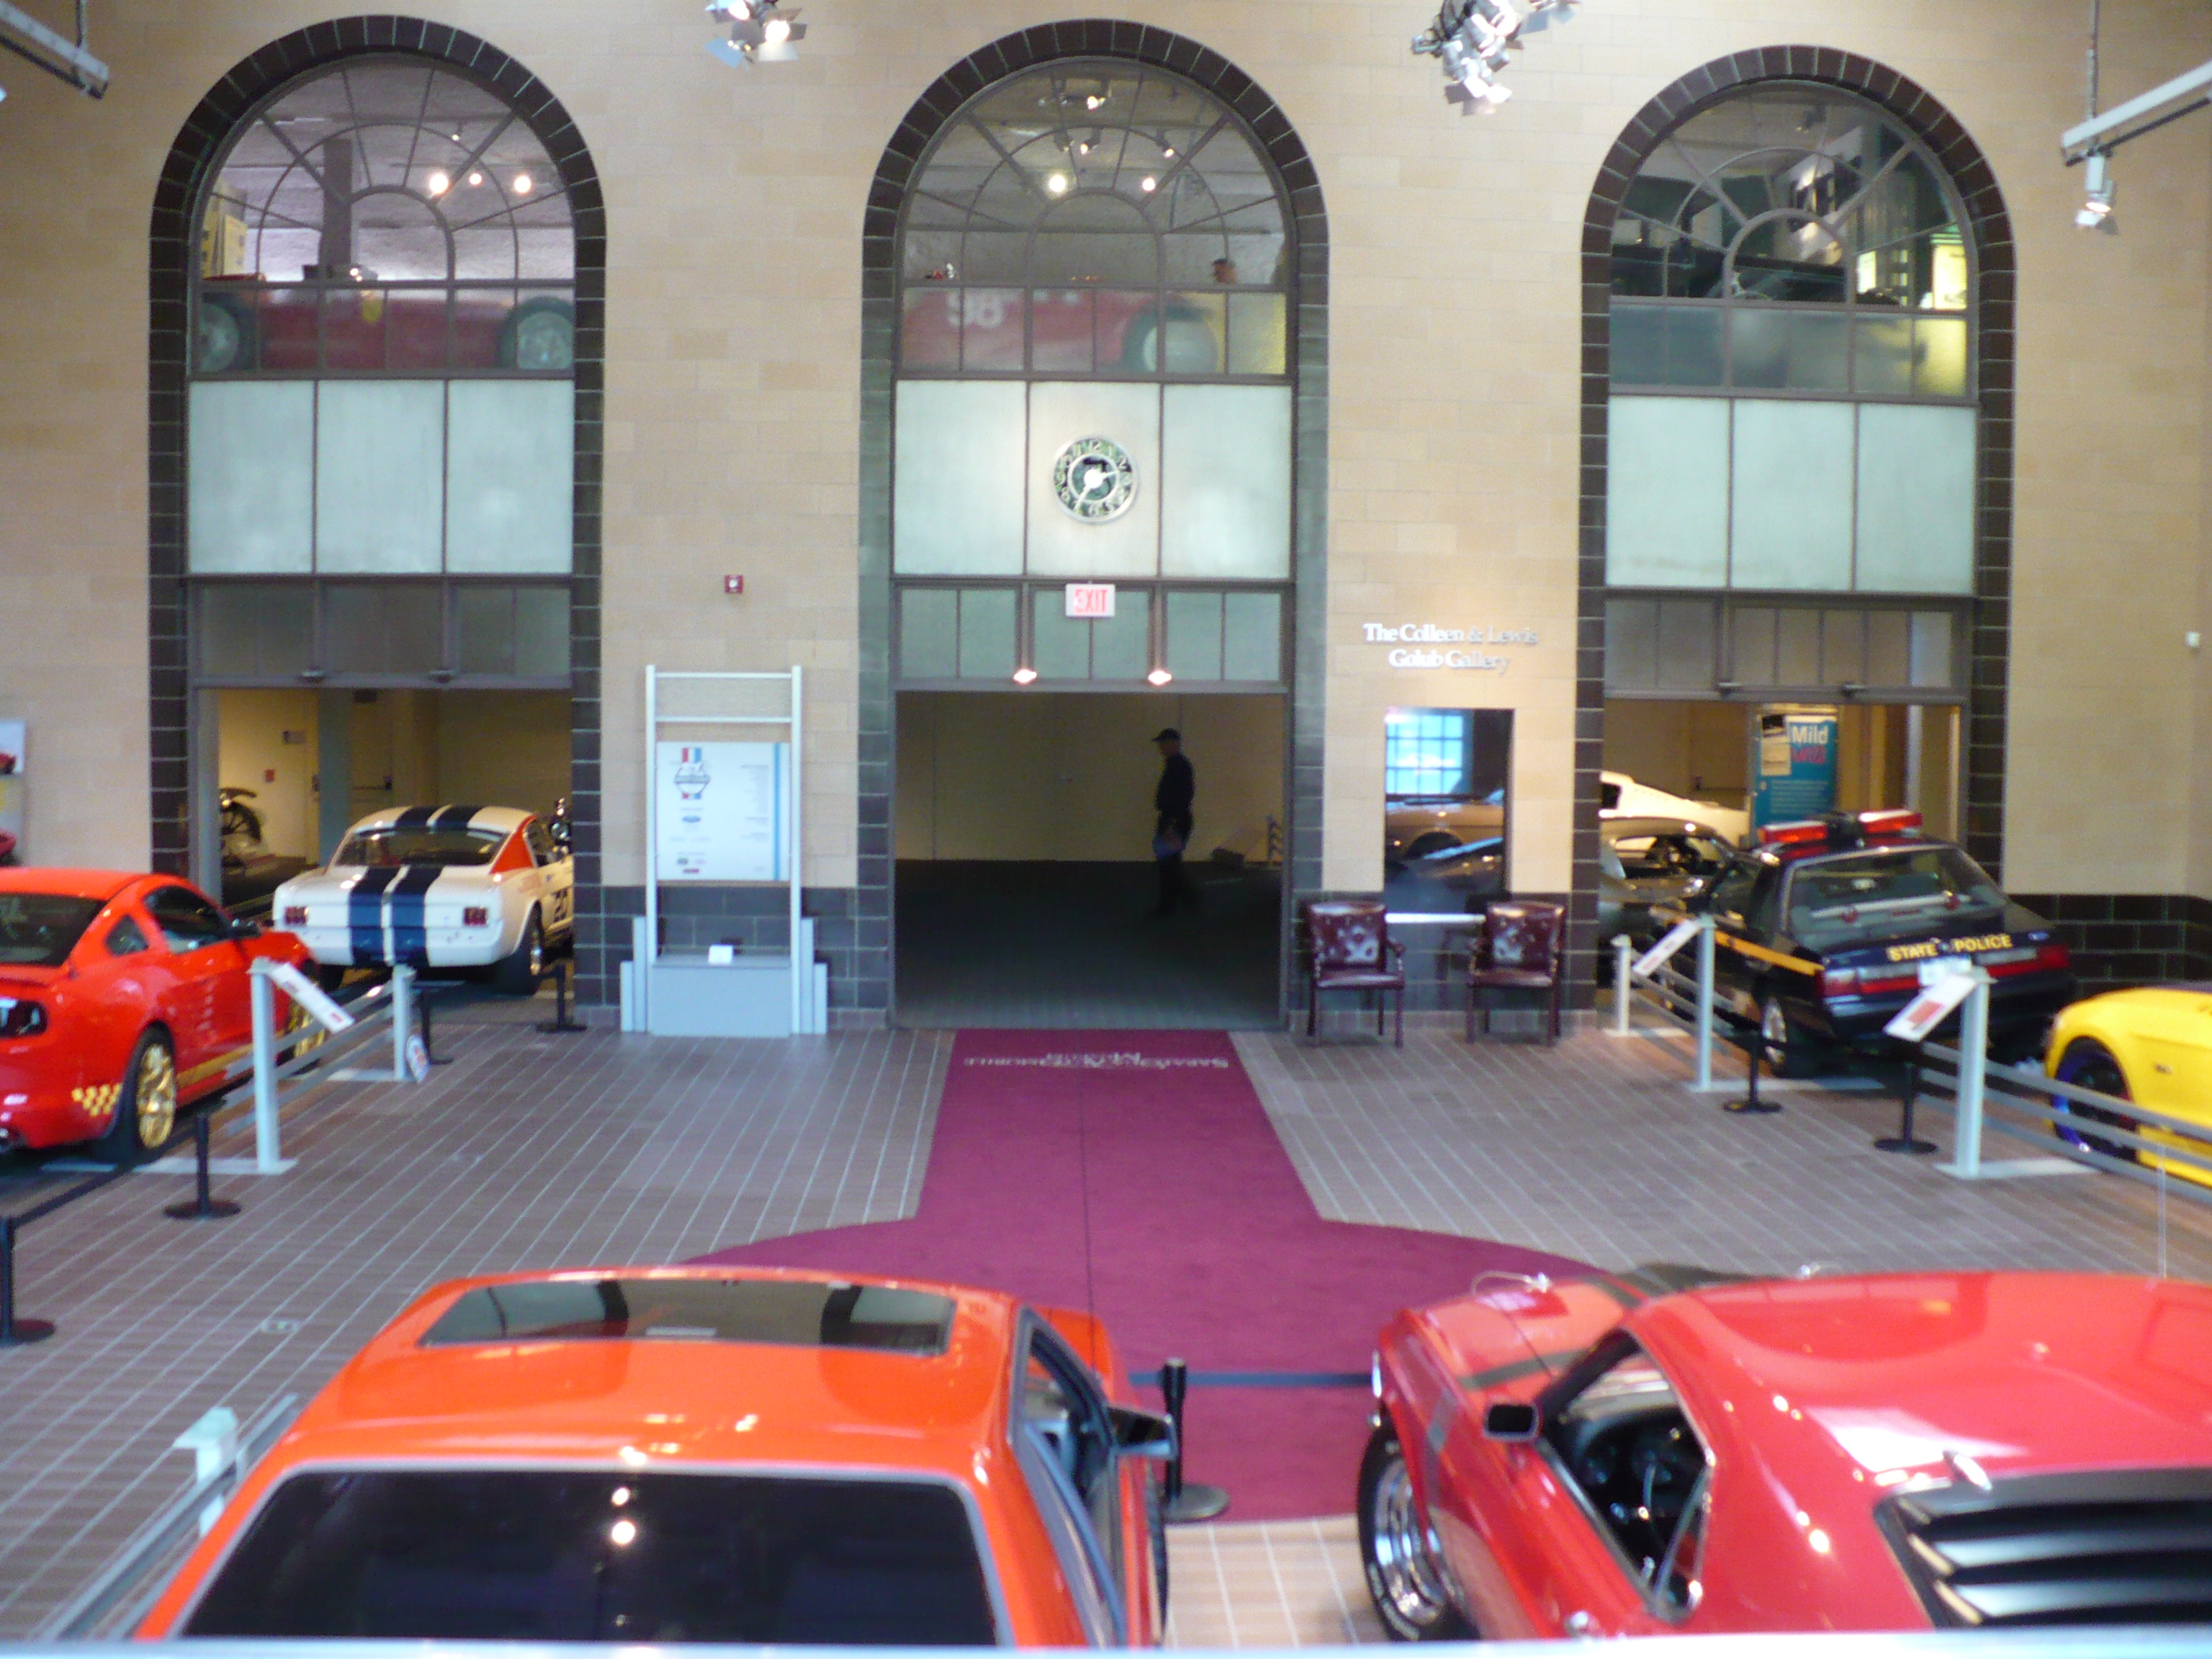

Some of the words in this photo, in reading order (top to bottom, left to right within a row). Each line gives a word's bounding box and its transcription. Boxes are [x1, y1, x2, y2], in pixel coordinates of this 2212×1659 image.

[1074, 588, 1107, 613] EXIT
[1363, 622, 1398, 642] The
[1399, 624, 1465, 642] Colleen
[1469, 626, 1483, 644] &
[1487, 625, 1539, 645] Lewis
[1444, 649, 1511, 675] Gallery
[1791, 724, 1828, 744] Mild
[1885, 942, 1938, 962] STATE
[1950, 933, 2013, 953] POLICE
